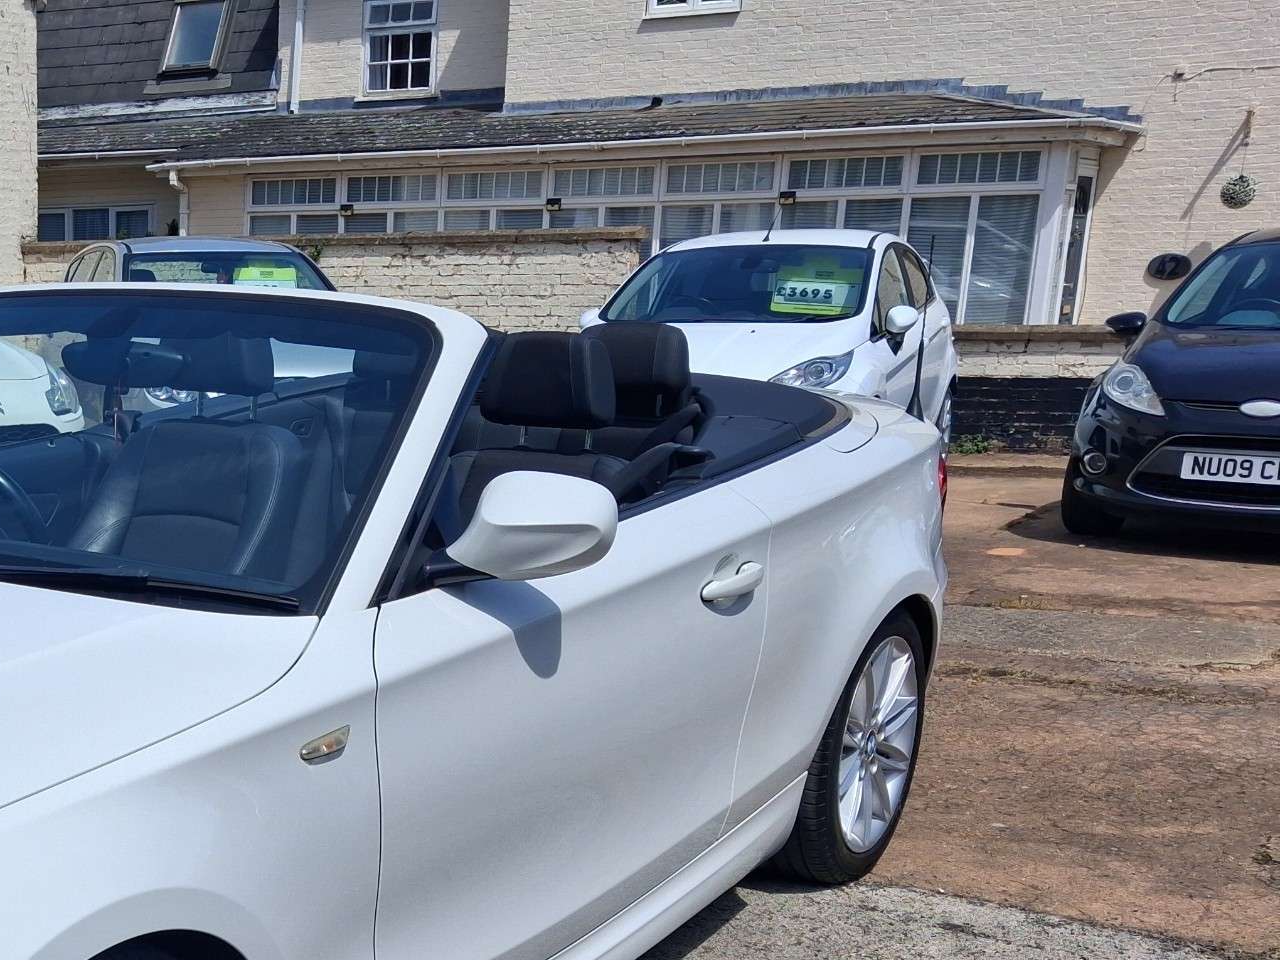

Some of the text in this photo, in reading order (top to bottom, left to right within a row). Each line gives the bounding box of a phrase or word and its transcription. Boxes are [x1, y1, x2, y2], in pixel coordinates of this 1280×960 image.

[776, 286, 833, 299] £3695
[1191, 455, 1280, 480] NU09 C
